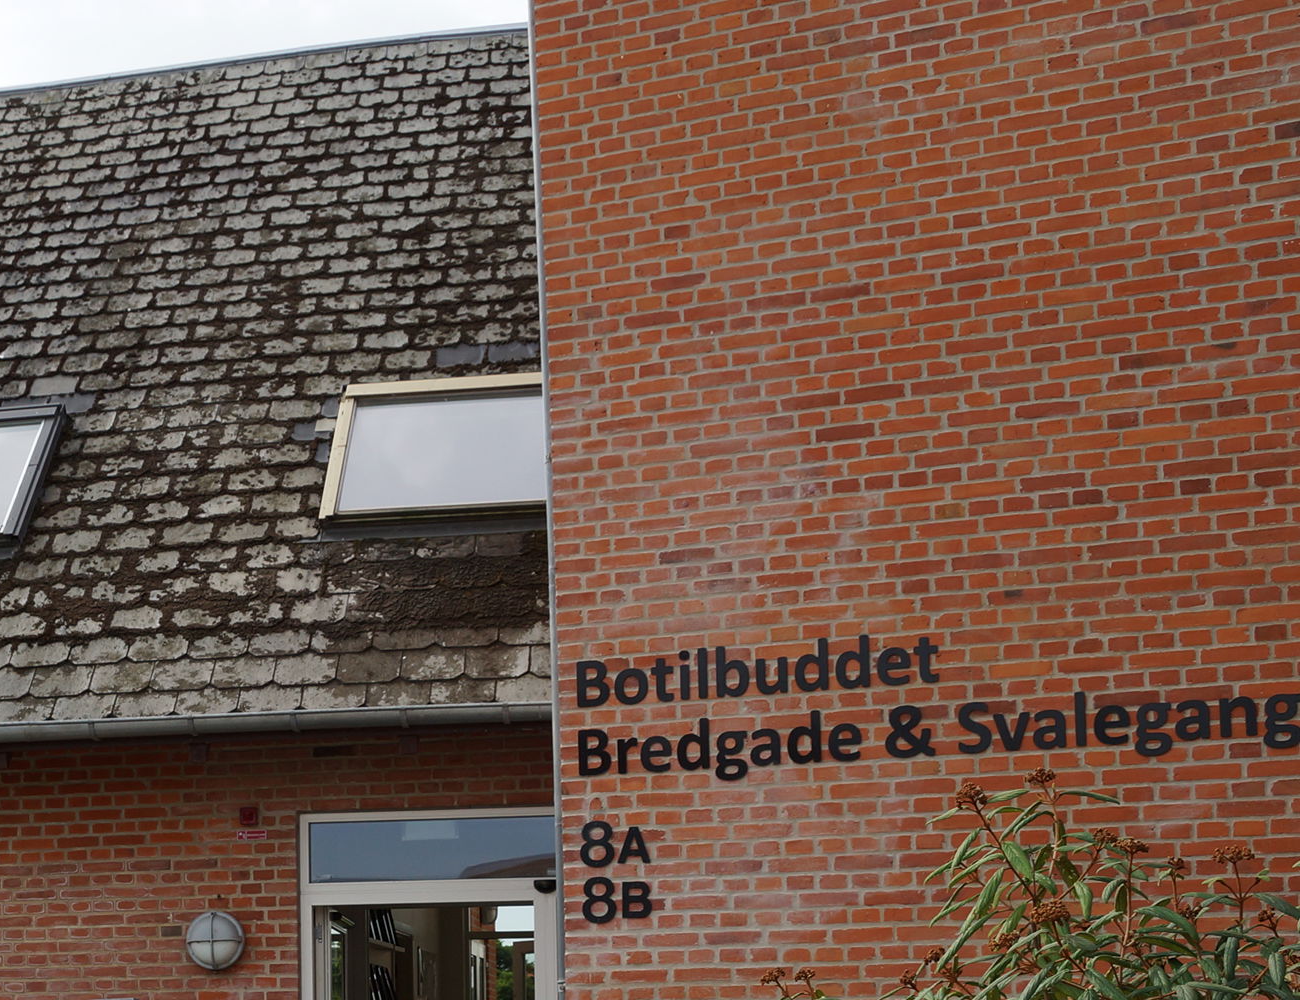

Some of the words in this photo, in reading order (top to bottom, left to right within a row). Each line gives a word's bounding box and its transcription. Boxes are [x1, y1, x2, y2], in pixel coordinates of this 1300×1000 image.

[575, 634, 941, 709] Botilbuddet
[577, 709, 864, 782] Bredgade
[884, 704, 937, 759] &
[579, 820, 652, 869] 8A
[582, 876, 653, 925] 8B
